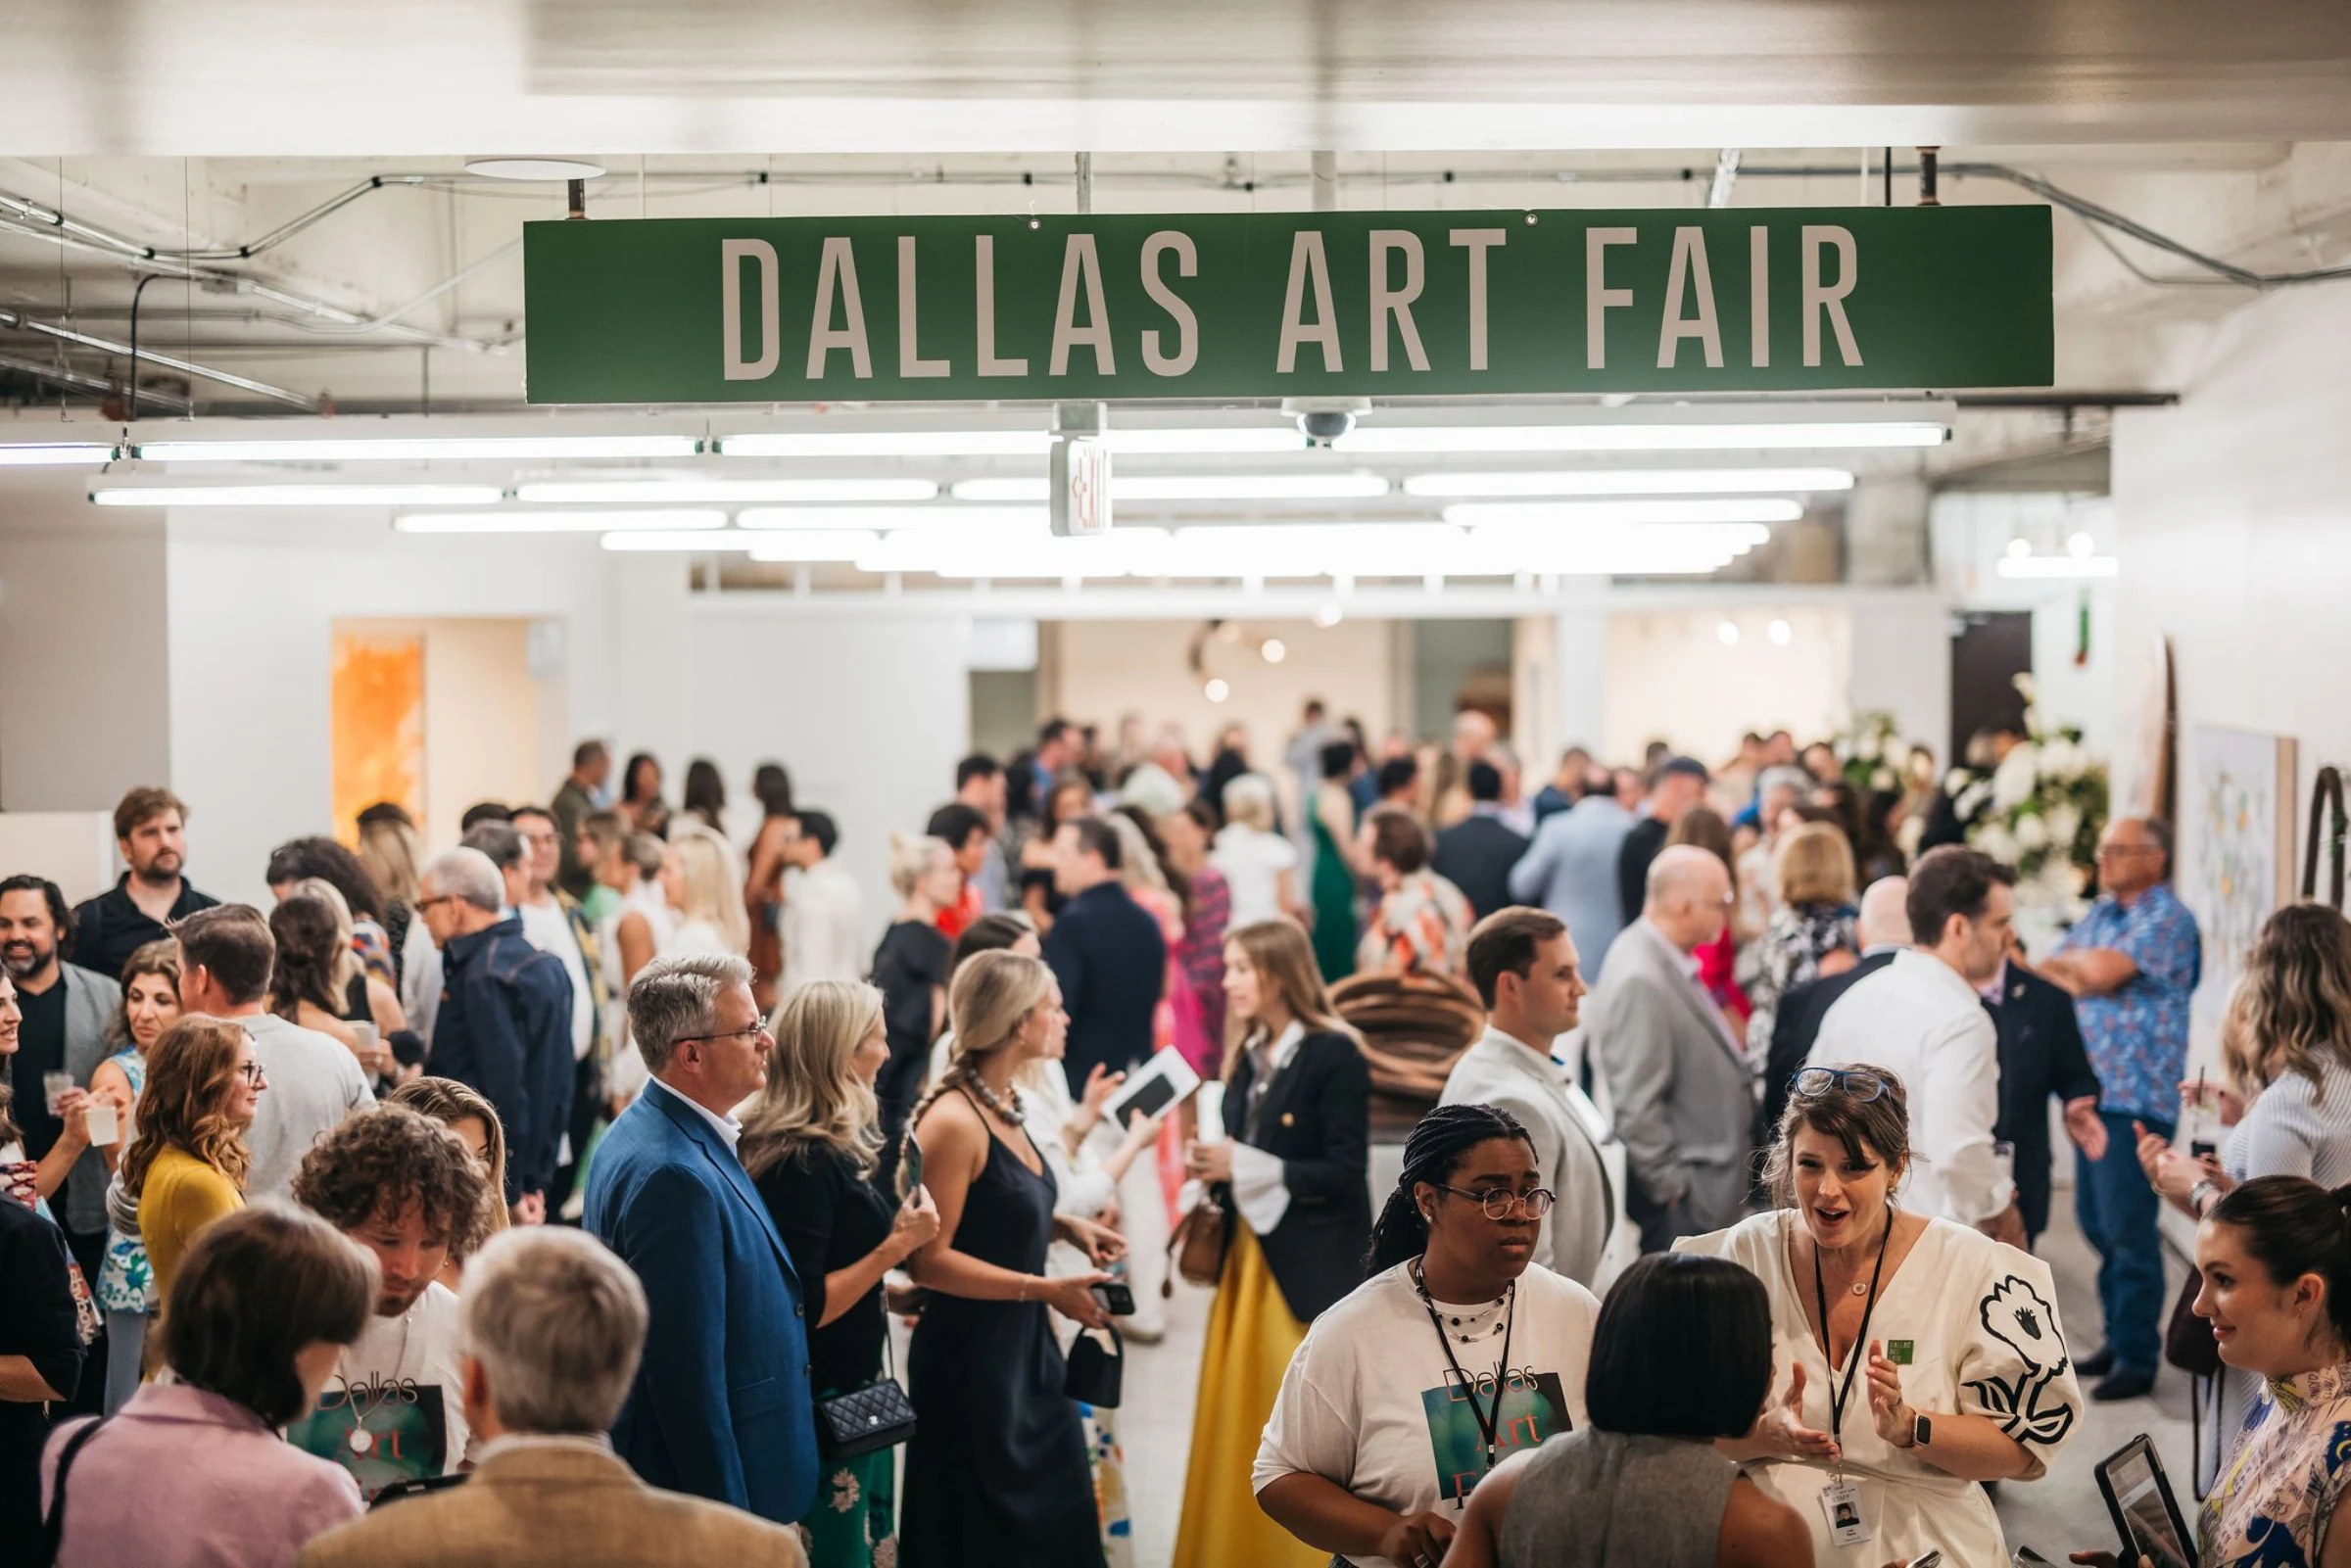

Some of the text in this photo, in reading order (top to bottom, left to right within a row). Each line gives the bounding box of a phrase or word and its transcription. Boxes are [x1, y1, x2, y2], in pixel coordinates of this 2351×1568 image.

[722, 226, 1863, 381] DALLAS ART FAIR
[318, 1370, 417, 1410] Dallas
[1443, 1360, 1538, 1402] Dallas
